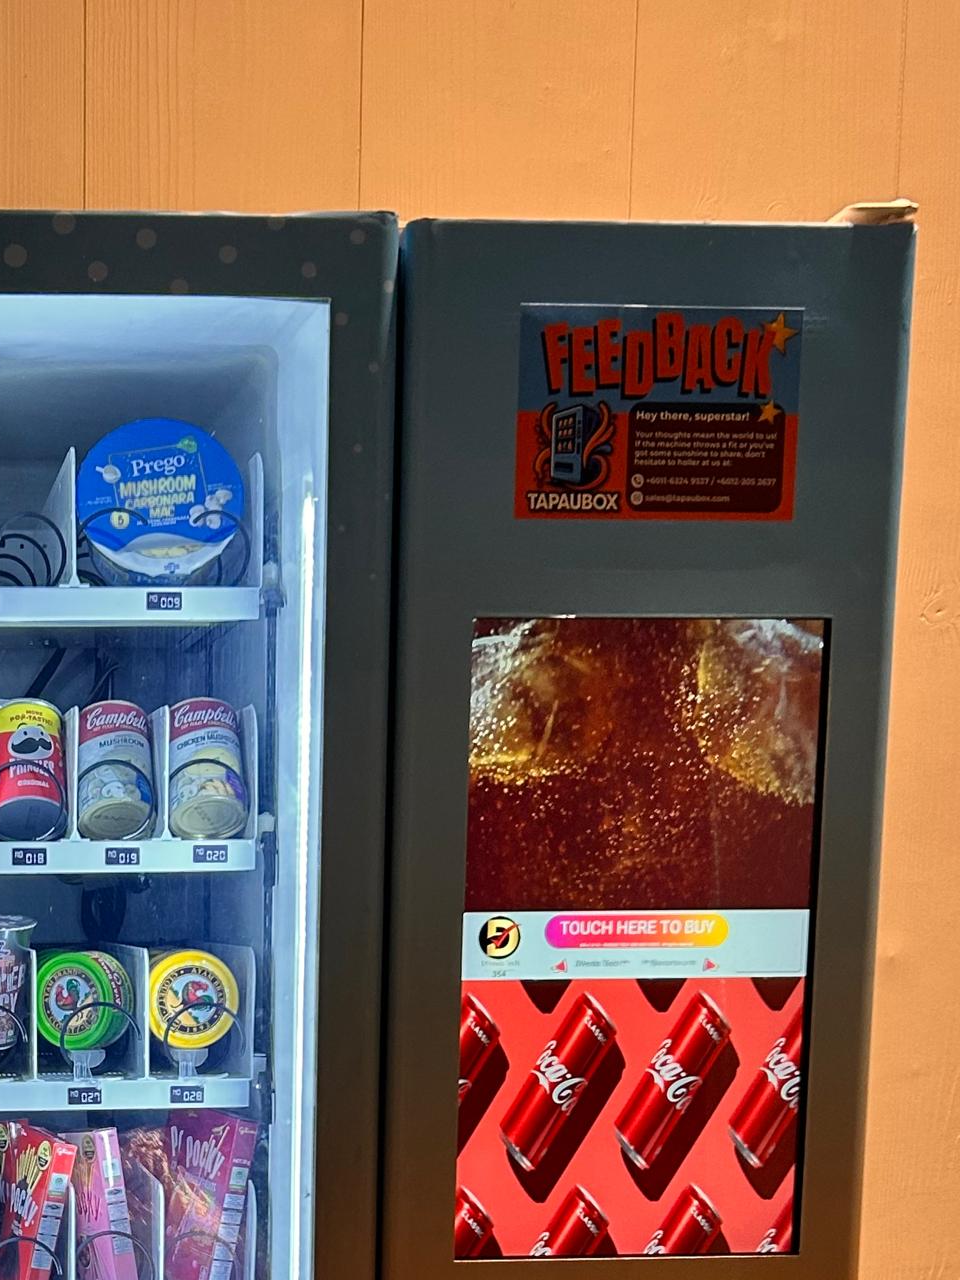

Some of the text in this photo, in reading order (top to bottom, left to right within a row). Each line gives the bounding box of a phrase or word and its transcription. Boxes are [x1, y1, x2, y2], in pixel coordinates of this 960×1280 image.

[541, 312, 778, 399] FEEDBACK
[636, 411, 750, 423] Hey there, superstar!
[130, 454, 186, 477] Prego
[120, 474, 196, 498] MUSHROOM
[125, 491, 195, 510] CARBONARA
[527, 493, 618, 511] TAPAUBOX
[149, 505, 176, 518] MAC
[161, 597, 180, 608] 009
[26, 853, 44, 863] 018
[119, 853, 136, 863] 019
[206, 851, 225, 860] 020
[560, 919, 716, 936] TOUCH HERE TO BUY
[184, 1091, 202, 1101] 028
